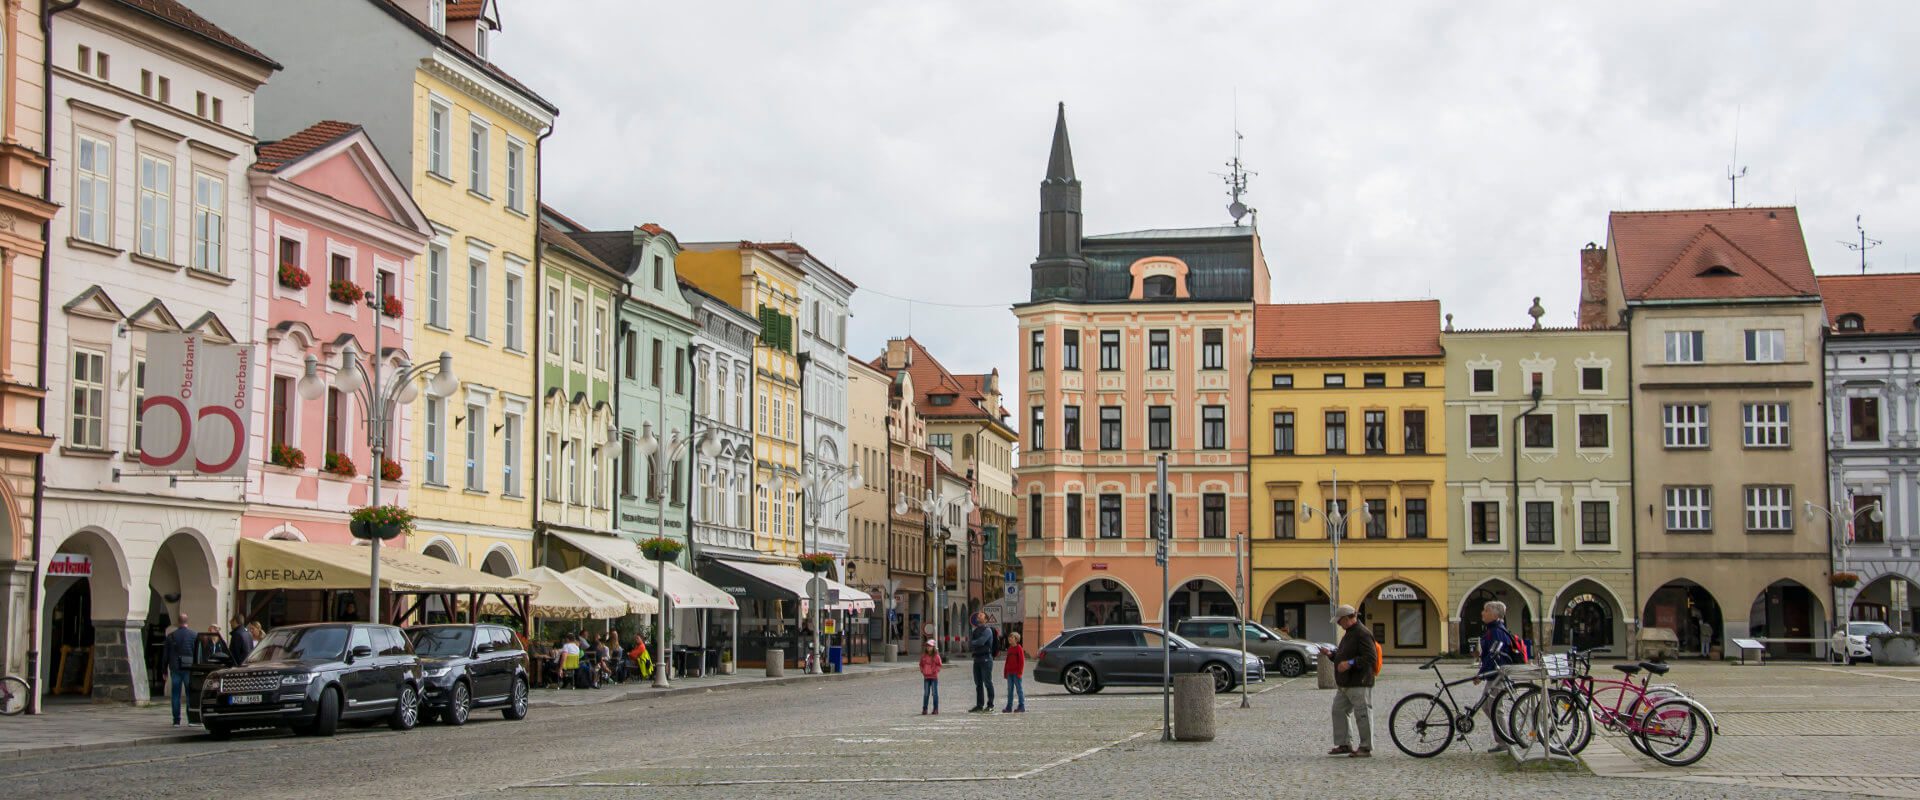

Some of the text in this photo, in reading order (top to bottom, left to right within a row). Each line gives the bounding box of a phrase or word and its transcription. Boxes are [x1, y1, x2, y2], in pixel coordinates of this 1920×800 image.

[181, 336, 195, 399] Oberbank
[234, 348, 248, 409] Oberbank
[48, 556, 91, 574] berbank
[245, 569, 324, 581] CAFE PLAZA
